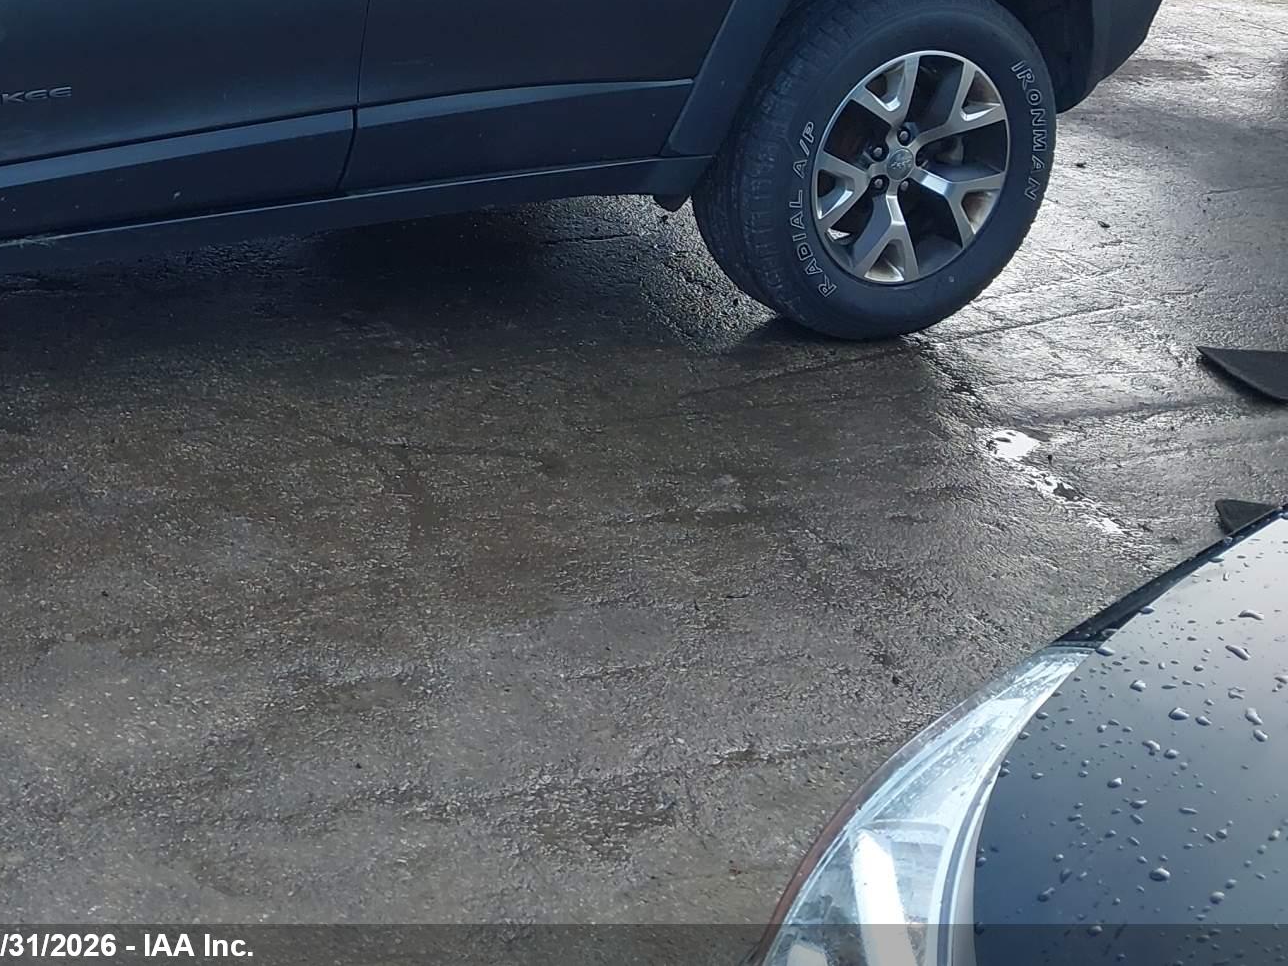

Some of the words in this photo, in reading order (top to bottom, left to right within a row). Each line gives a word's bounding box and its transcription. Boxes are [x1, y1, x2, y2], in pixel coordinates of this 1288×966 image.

[792, 120, 815, 180] A/P
[1010, 60, 1052, 202] IRONMAN
[789, 189, 838, 298] RADIAL
